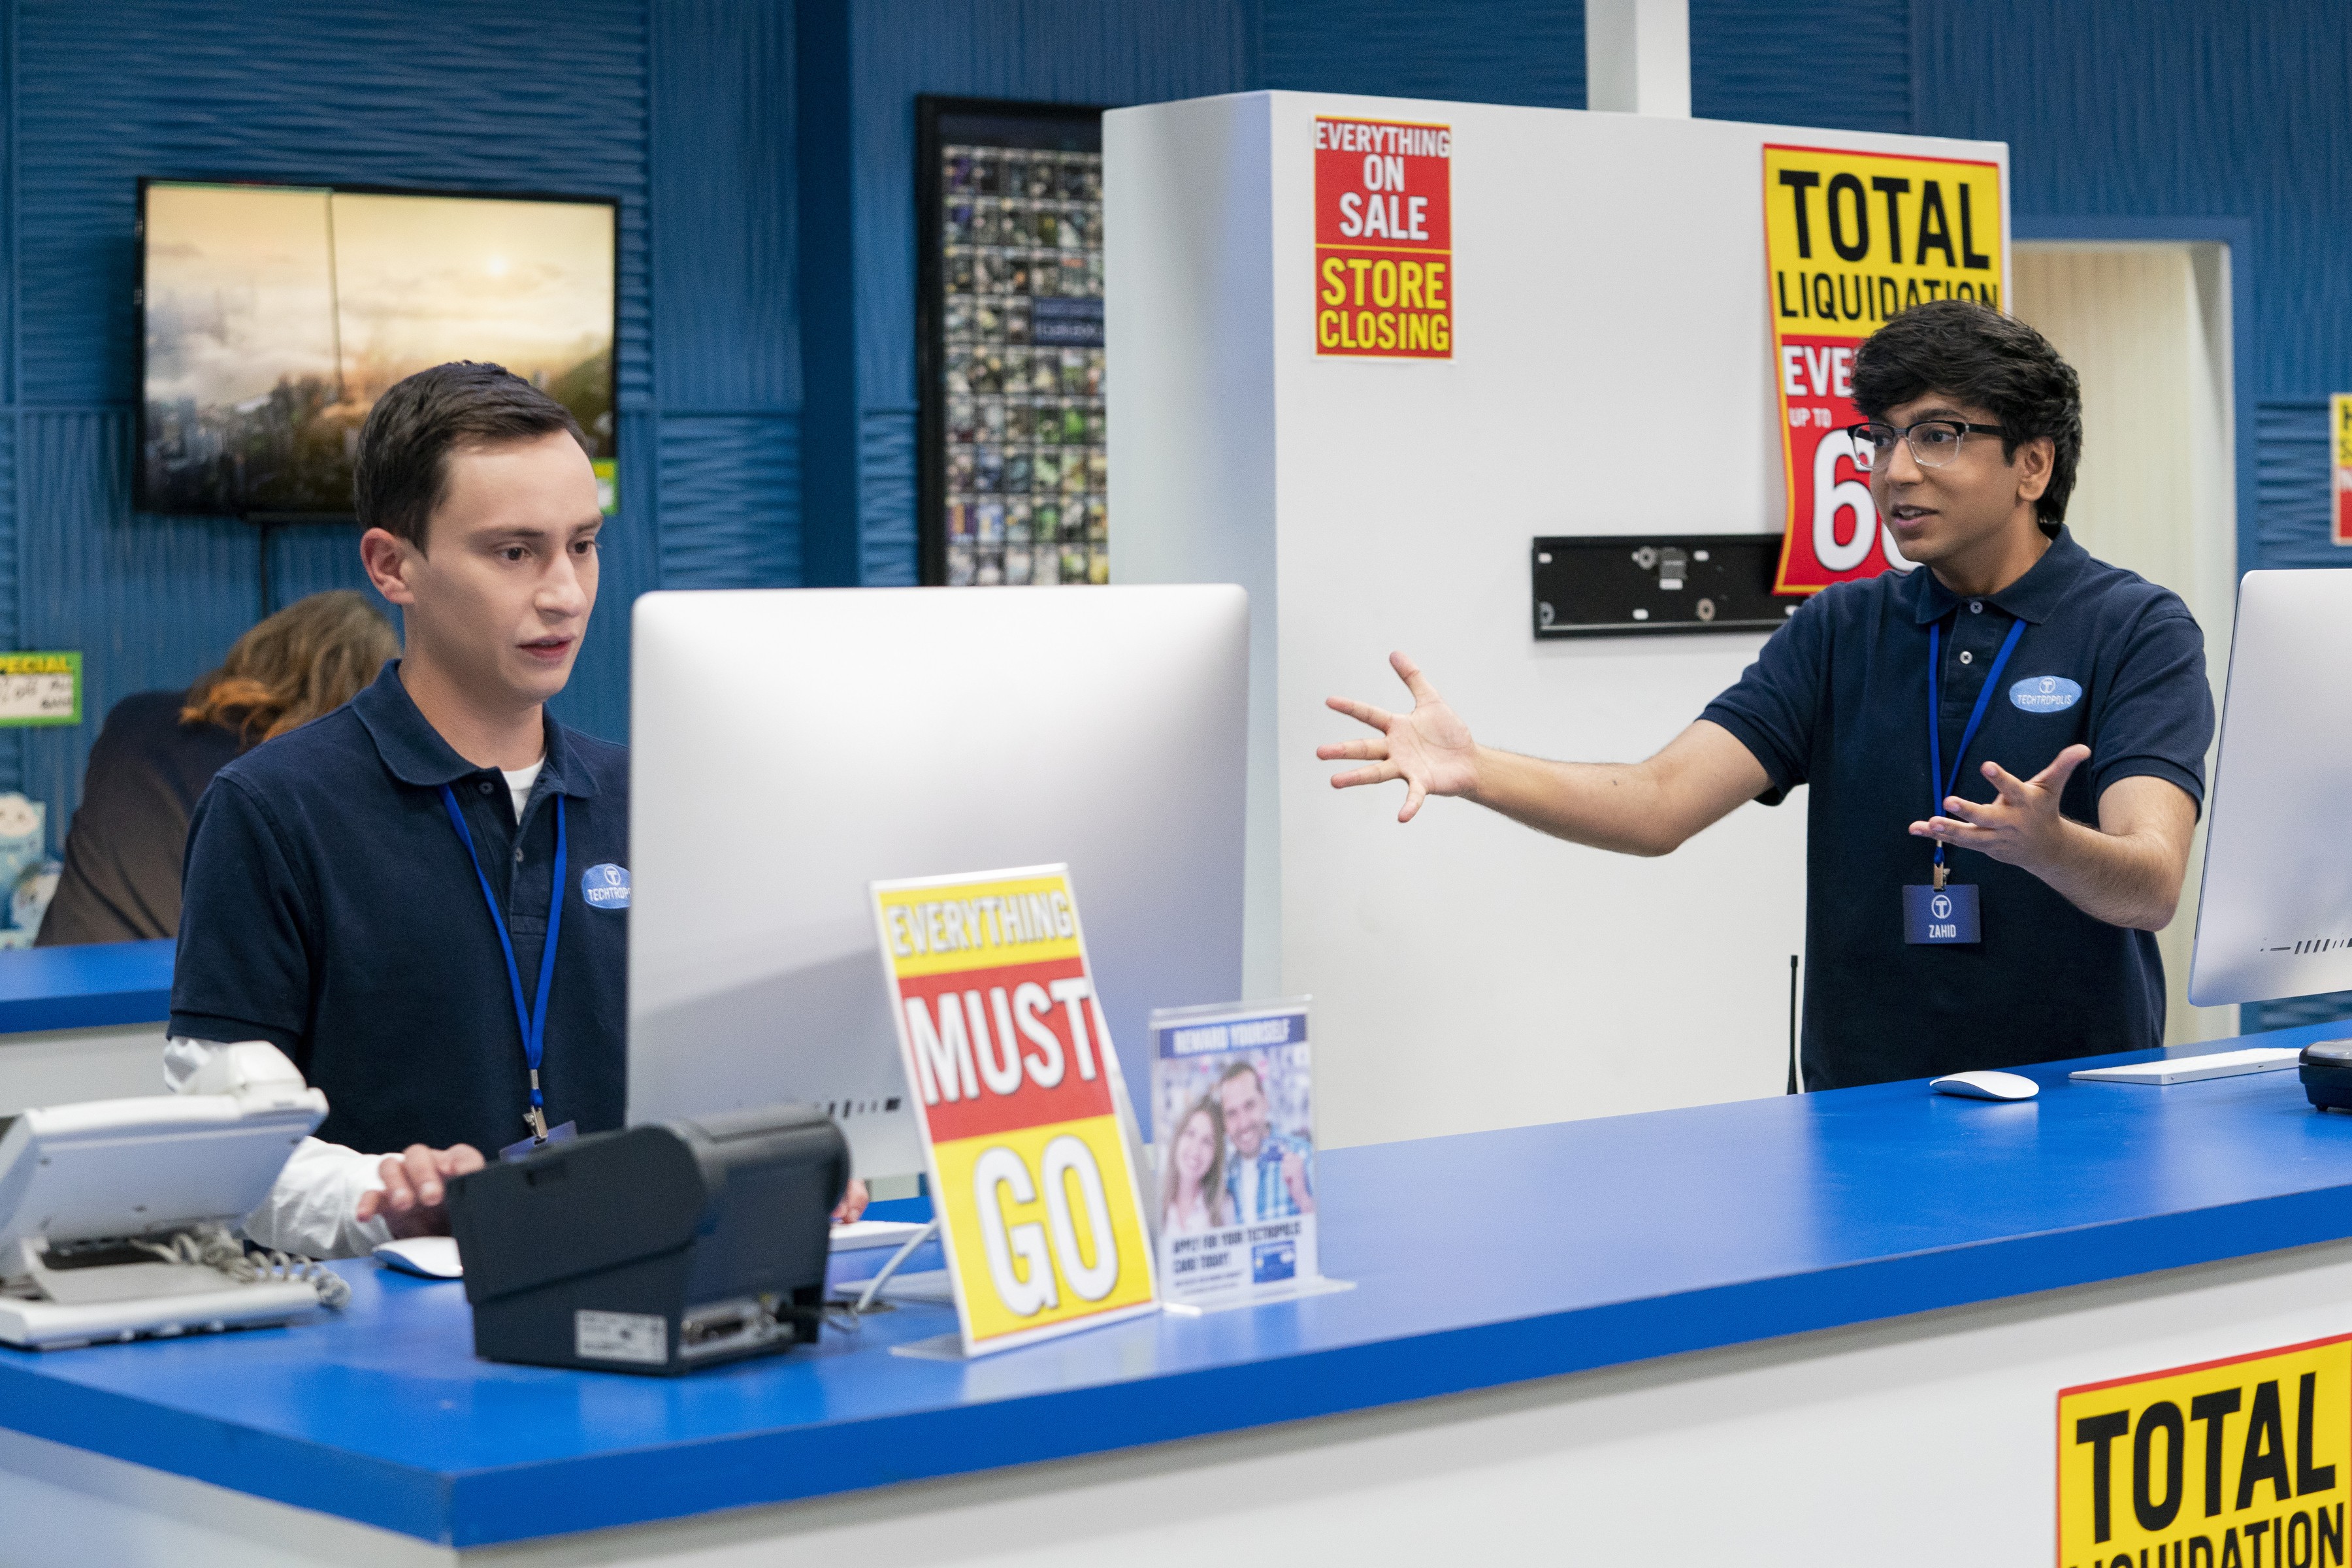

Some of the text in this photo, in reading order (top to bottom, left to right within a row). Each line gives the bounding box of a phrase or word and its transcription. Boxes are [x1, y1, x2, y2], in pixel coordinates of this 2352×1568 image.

[1315, 121, 1450, 158] EVERYTHING
[1363, 153, 1405, 193] ON
[1339, 191, 1429, 241] SALE
[1778, 169, 1990, 270] TOTAL
[1321, 256, 1446, 310] STORE
[1319, 309, 1450, 351] CLOSING
[1782, 344, 1861, 398] EVE
[1789, 406, 1833, 428] UP TO
[1812, 428, 1925, 572] 6
[2017, 694, 2072, 705] TECHTROPOLIS
[887, 890, 1073, 958] EVERYTHING
[1929, 924, 1957, 938] ZAHID
[904, 976, 1097, 1107] MUST
[973, 1134, 1120, 1318] GO
[1221, 1231, 1243, 1247] YOUR
[2076, 1371, 2336, 1544] TOTAL
[2068, 1501, 2345, 1568] DATION
